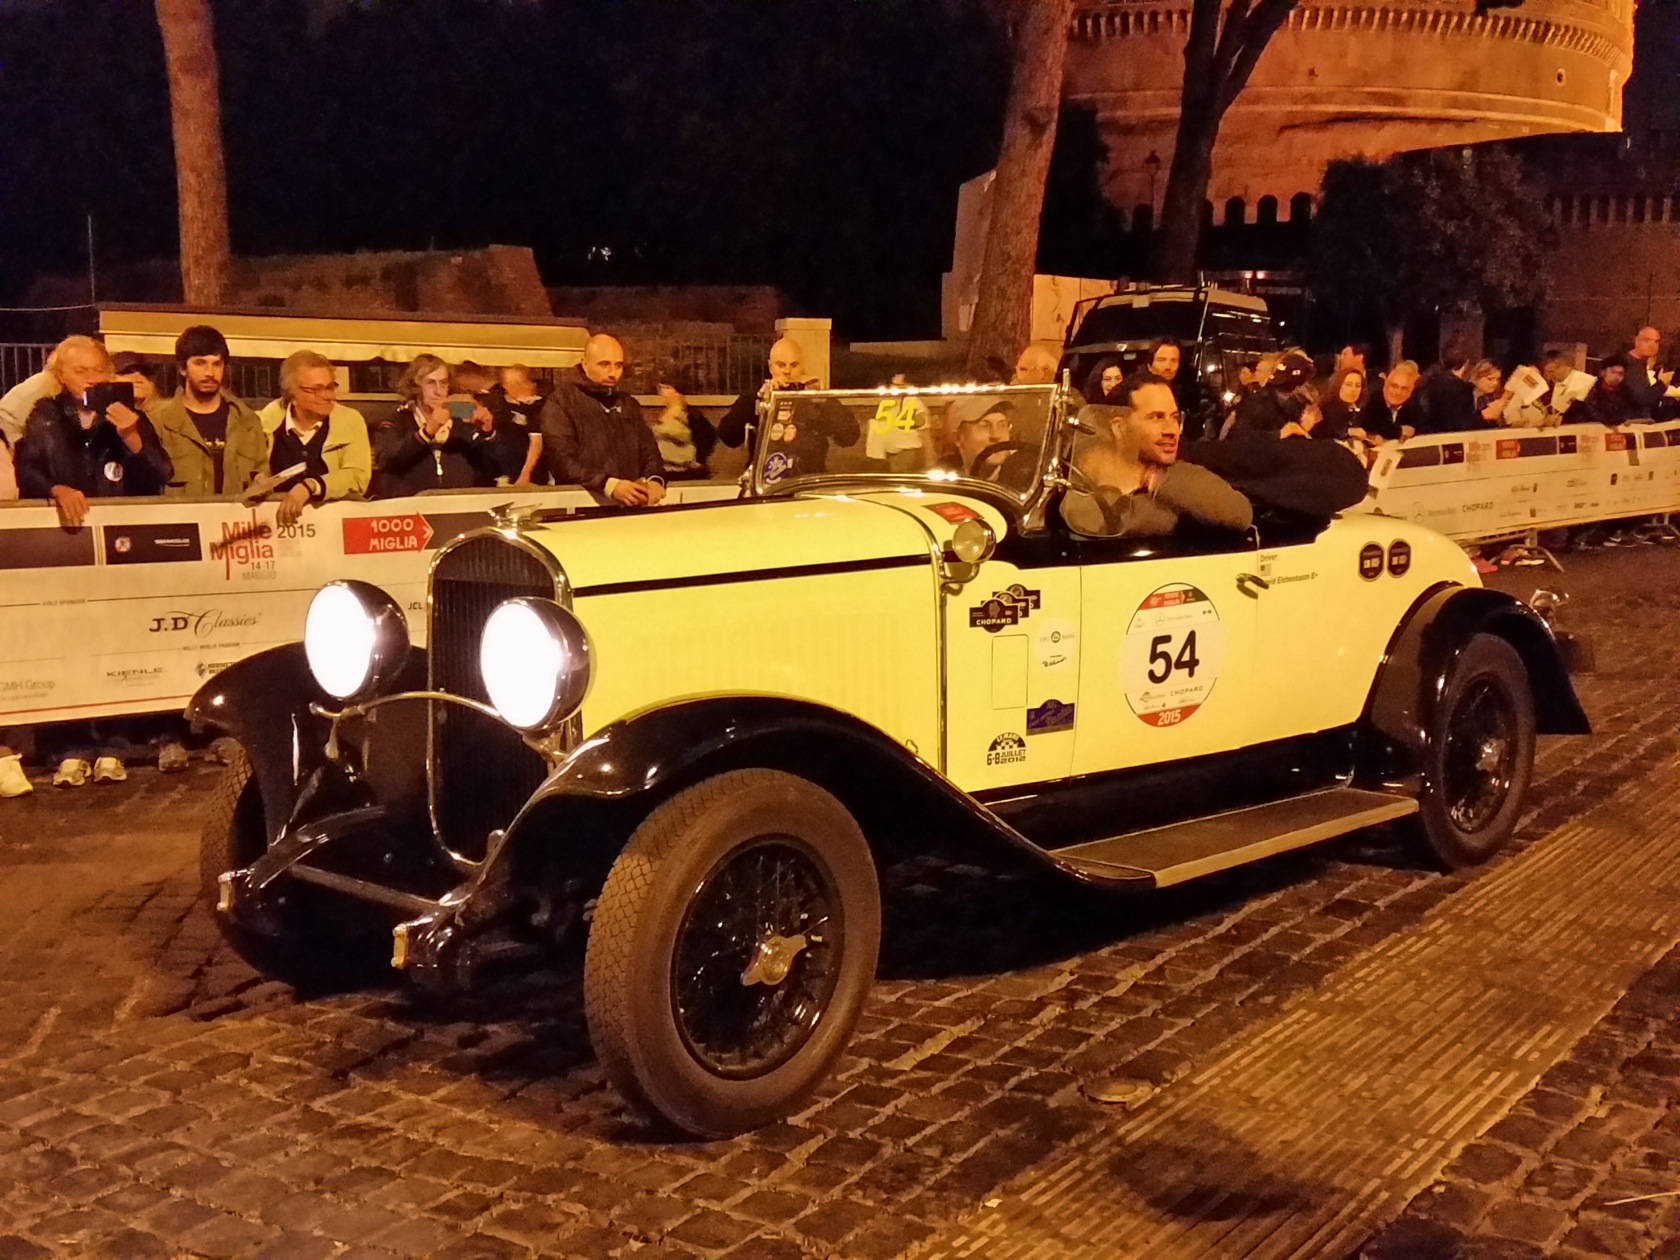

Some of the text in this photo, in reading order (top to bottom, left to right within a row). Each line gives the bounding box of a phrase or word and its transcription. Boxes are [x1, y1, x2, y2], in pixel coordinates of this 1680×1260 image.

[875, 400, 915, 435] 54
[1462, 501, 1494, 513] CHOPARD
[221, 508, 316, 542] Mille 2015
[371, 518, 414, 533] 1000
[369, 535, 418, 551] MIGLIA
[209, 541, 274, 580] Miglia
[408, 602, 423, 610] JCL
[149, 609, 258, 638] J.D Classics
[976, 617, 1012, 626] CHOPARD
[1148, 629, 1200, 684] 54
[106, 667, 163, 677] KIENLE
[1170, 685, 1204, 697] CHOPARD
[1157, 709, 1182, 726] 2015
[1000, 756, 1026, 764] 2012
[1001, 748, 1026, 758] JUILLET
